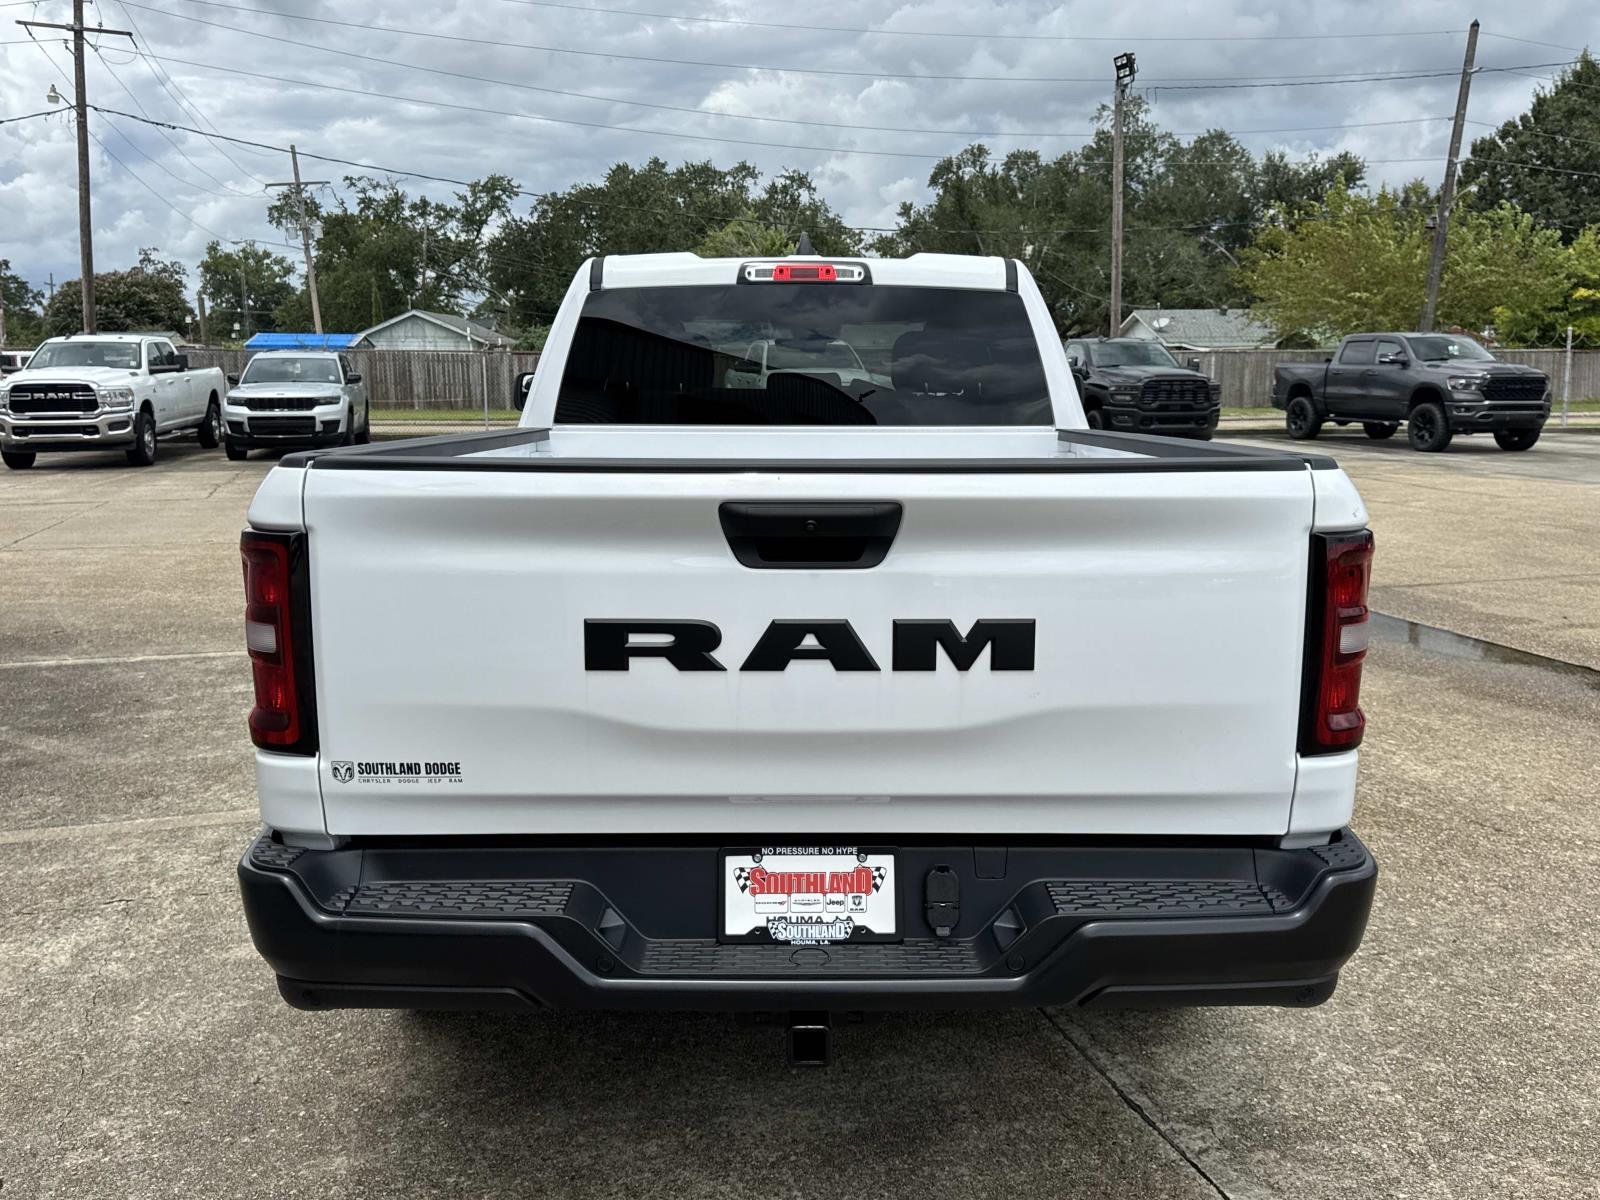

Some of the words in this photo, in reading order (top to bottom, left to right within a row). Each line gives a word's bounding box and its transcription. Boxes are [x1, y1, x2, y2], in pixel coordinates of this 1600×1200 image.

[584, 618, 1036, 671] RAM
[358, 762, 421, 775] SOUTHLAND
[425, 762, 461, 775] DODGE
[762, 847, 774, 855] NO
[776, 847, 820, 855] PRESSURE
[821, 847, 834, 855] NO
[836, 847, 857, 855] HYPE
[749, 867, 873, 896] SOUTHLAND
[827, 898, 845, 906] Jeep
[777, 921, 846, 940] SOUTHLAND
